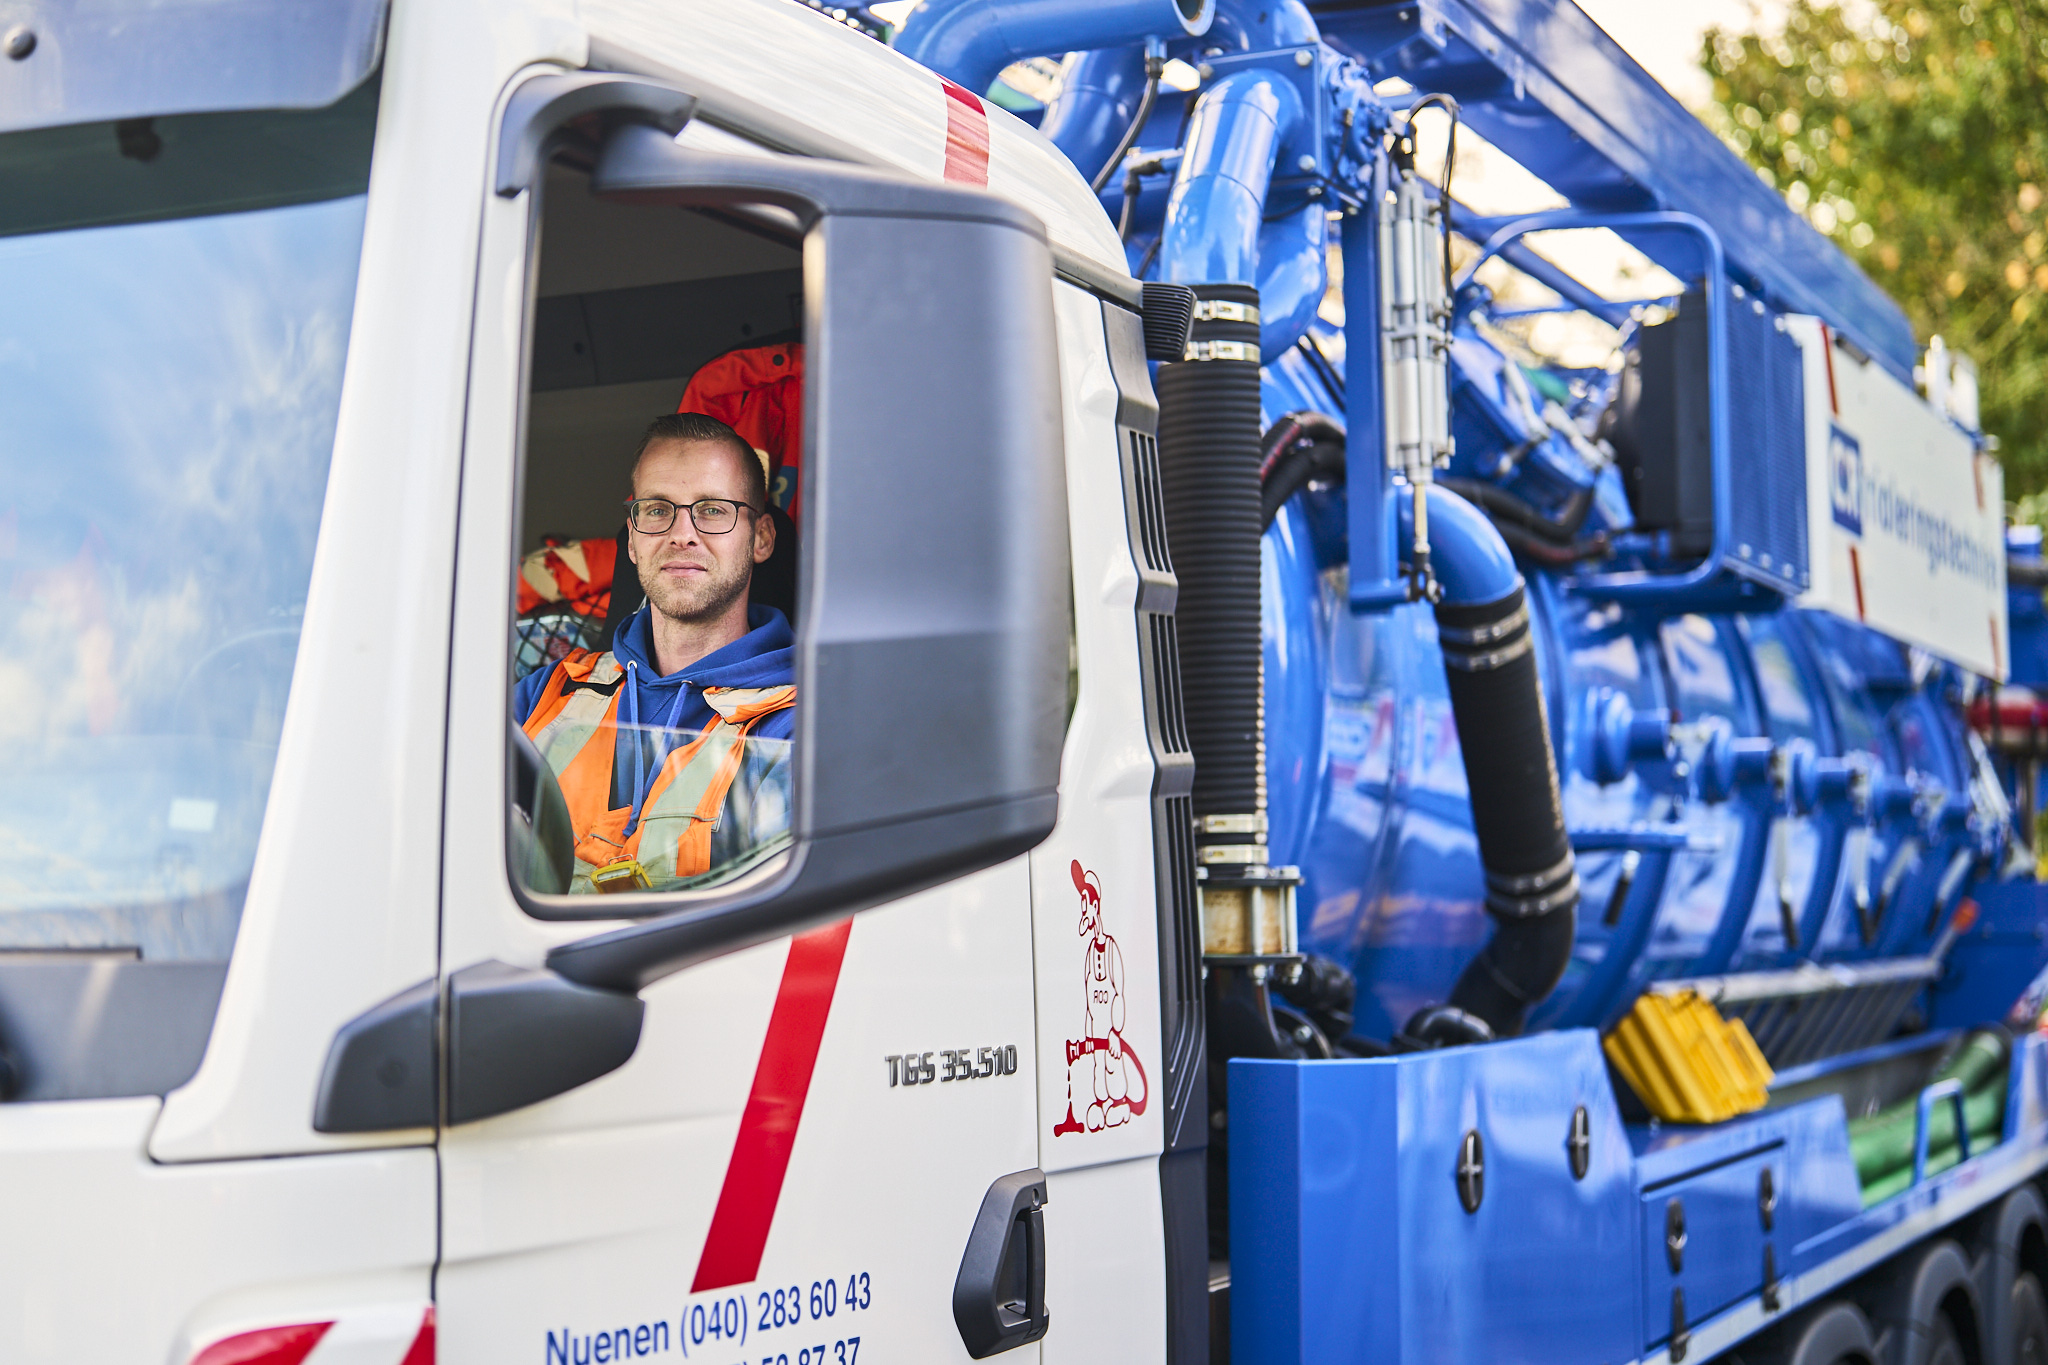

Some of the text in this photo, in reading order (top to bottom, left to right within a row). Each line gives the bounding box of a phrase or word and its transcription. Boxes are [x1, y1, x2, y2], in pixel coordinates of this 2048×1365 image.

[885, 1044, 1018, 1088] TGS 35.510
[546, 1271, 871, 1365] Nuenen (040) 283 60 43
[833, 1336, 861, 1365] 37
